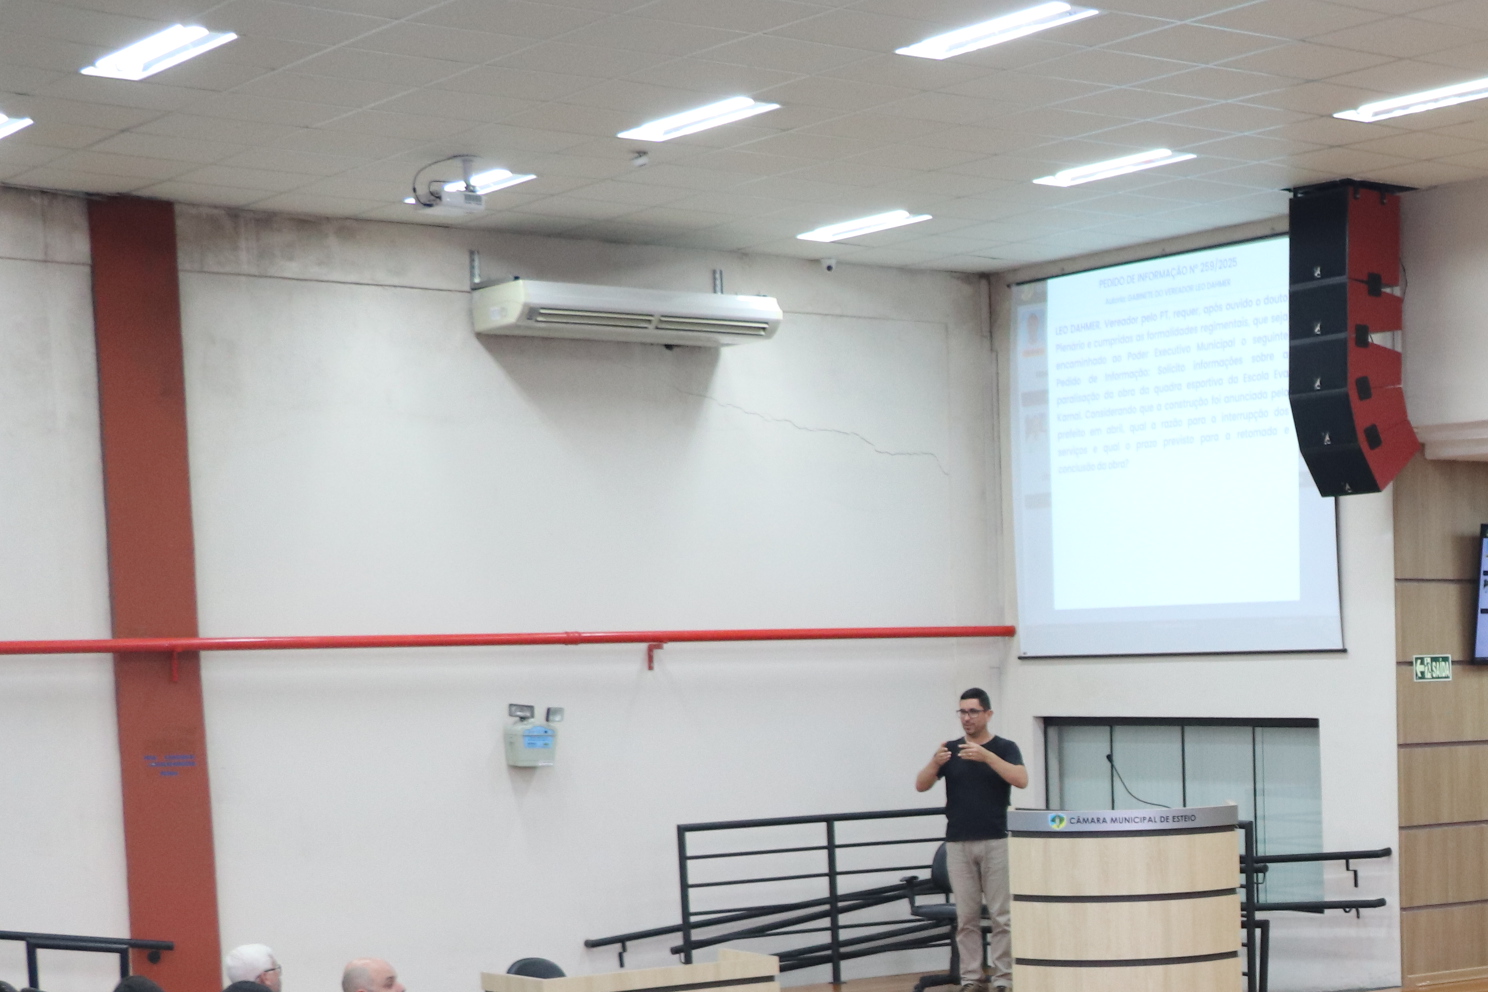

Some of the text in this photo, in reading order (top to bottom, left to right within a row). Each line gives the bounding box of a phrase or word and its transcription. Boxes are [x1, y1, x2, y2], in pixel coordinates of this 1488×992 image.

[1099, 277, 1125, 289] PEDIDO
[1126, 274, 1136, 285] DE
[1137, 264, 1188, 282] INFORMAÇÃO
[1200, 257, 1238, 273] 259/2025
[1055, 325, 1069, 336] LEO
[1104, 315, 1138, 328] Vereador
[1141, 312, 1158, 326] pelo
[1203, 301, 1223, 316] após
[1225, 298, 1254, 311] ouvido
[1255, 298, 1262, 307] o
[1263, 294, 1288, 305] douto
[1055, 339, 1085, 352] Plenário
[1094, 334, 1134, 349] cumpridas
[1135, 334, 1145, 342] as
[1147, 325, 1198, 341] formalidades
[1253, 316, 1269, 328] que
[1271, 311, 1288, 325] seja
[1056, 356, 1107, 370] encaminhado
[1112, 355, 1122, 363] ao
[1127, 350, 1149, 361] Poder
[1154, 345, 1191, 358] Executivo
[1197, 337, 1236, 352] Municipal
[1253, 332, 1288, 347] seguinte
[1056, 376, 1081, 387] Pedido
[1088, 374, 1098, 384] de
[1157, 364, 1185, 376] Solicito
[1193, 357, 1243, 371] informações
[1251, 352, 1275, 364] sobre
[1118, 388, 1136, 398] obra
[1154, 382, 1182, 396] quadra
[1187, 377, 1223, 391] esportiva
[1243, 370, 1269, 383] Escola
[1273, 369, 1289, 380] Eva
[1085, 404, 1137, 419] Considerando
[1139, 404, 1154, 416] que
[1164, 397, 1209, 411] construção
[1211, 394, 1221, 405] foi
[1224, 391, 1268, 403] anunciada
[1090, 428, 1102, 437] em
[1130, 421, 1147, 434] qual
[1161, 418, 1182, 430] razão
[1187, 416, 1206, 428] para
[1221, 409, 1269, 423] interrupção
[1103, 441, 1120, 454] qual
[1136, 439, 1157, 451] prazo
[1163, 435, 1195, 449] previsto
[1200, 432, 1219, 445] para
[1236, 426, 1278, 439] retomada
[1432, 657, 1450, 678] SAÍDA
[1069, 814, 1197, 825] CÂMARA MUNICIPAL DE ESTEIO
